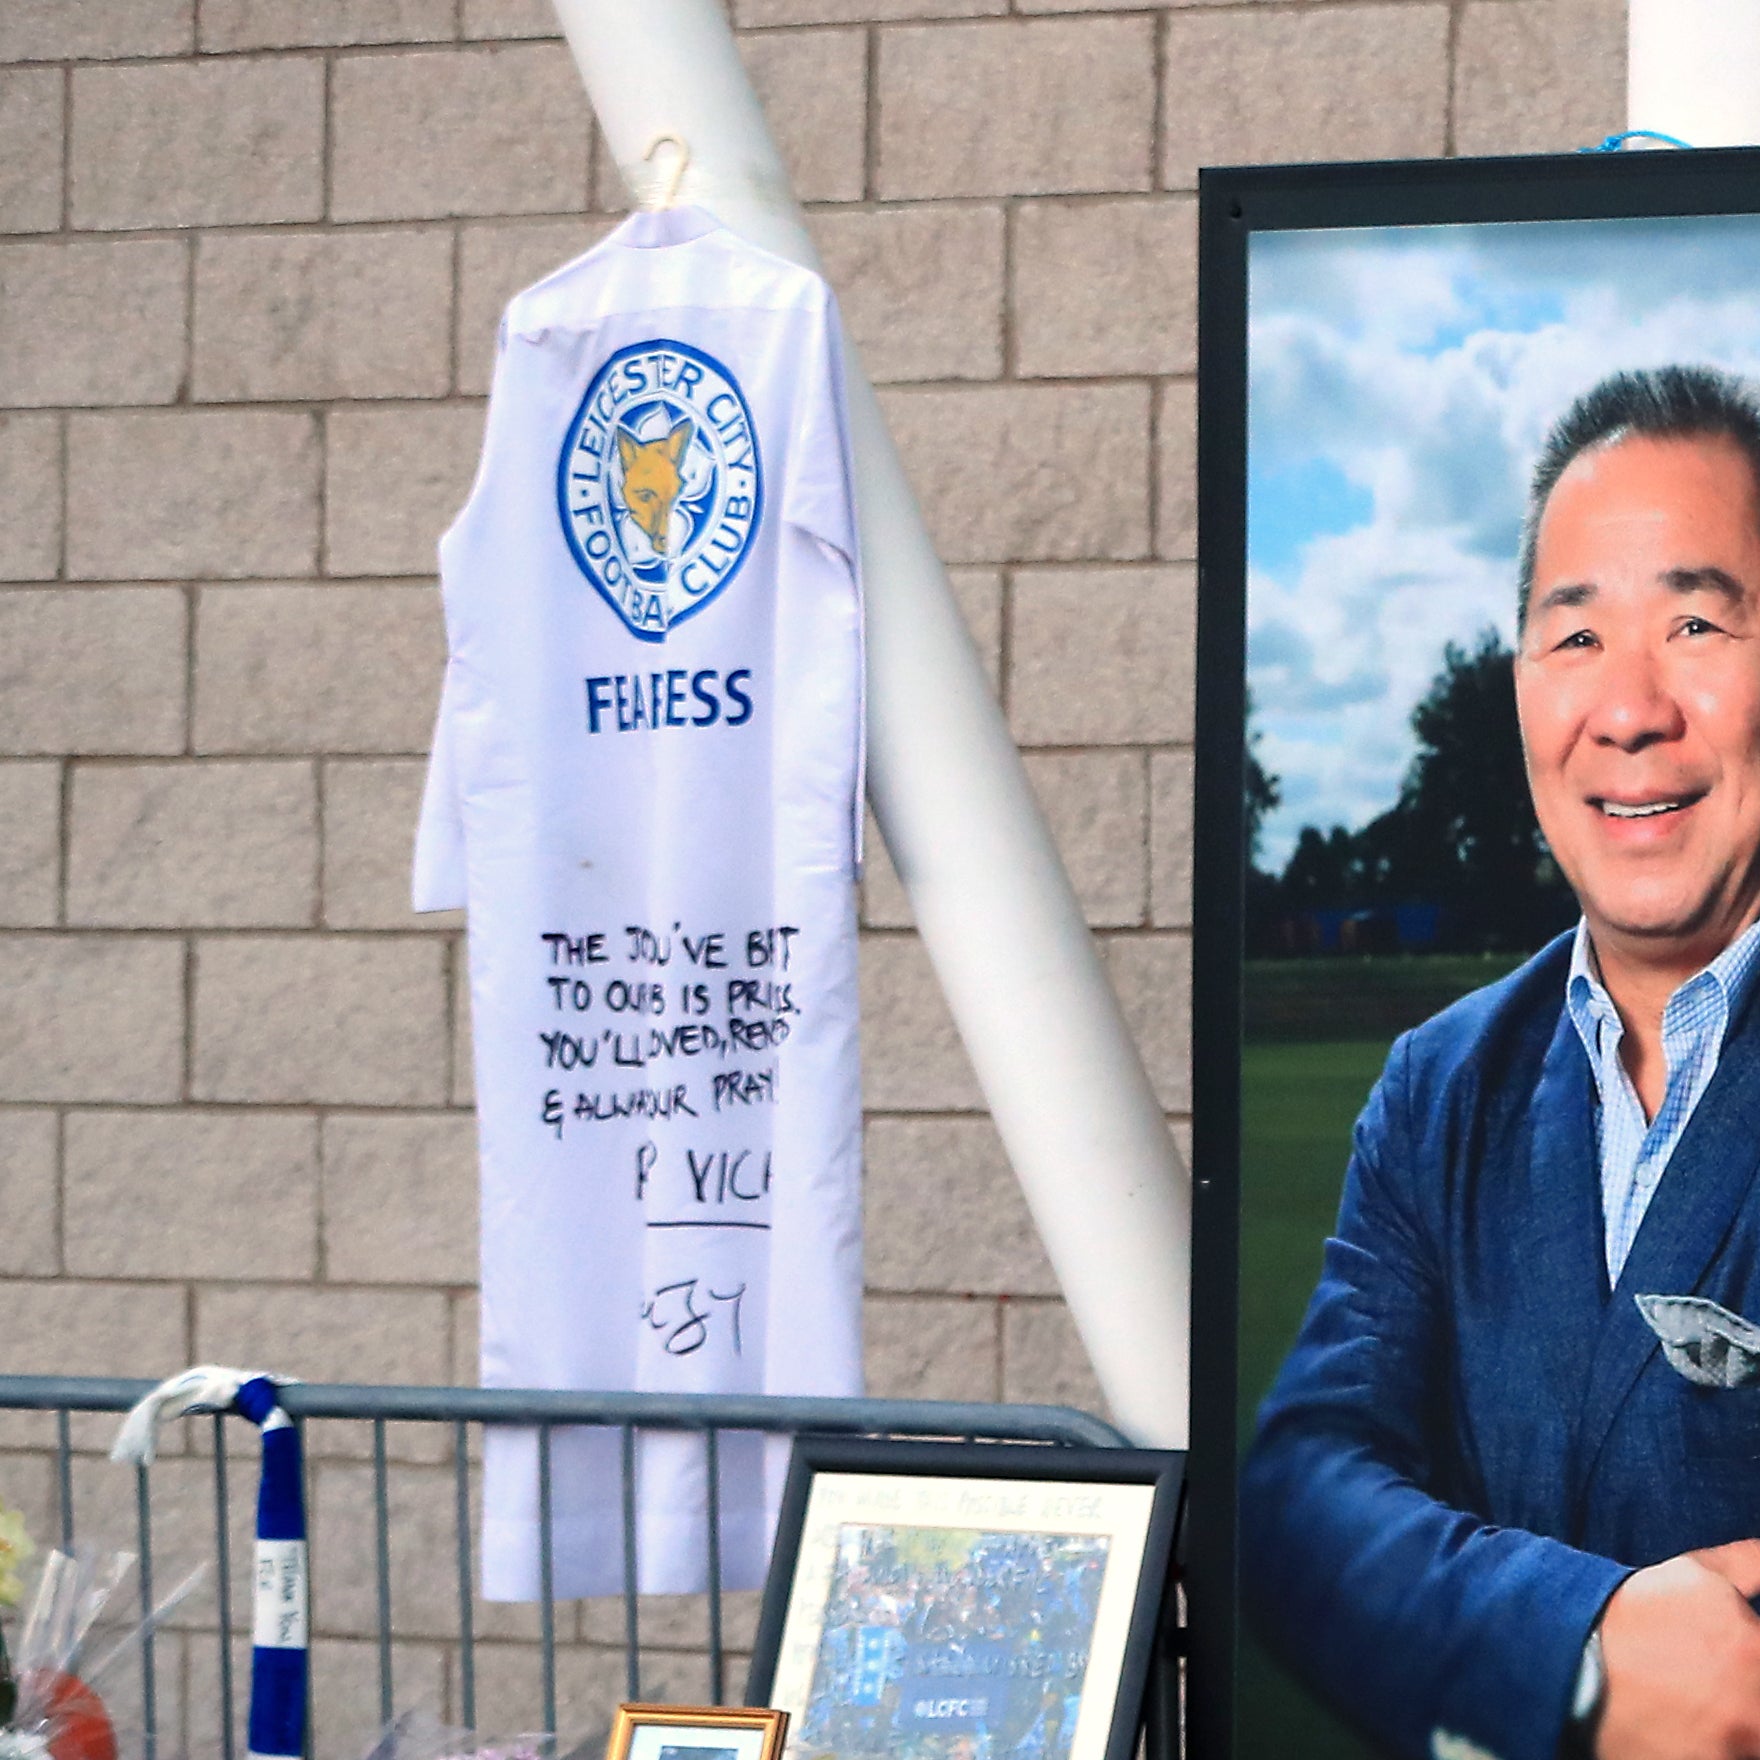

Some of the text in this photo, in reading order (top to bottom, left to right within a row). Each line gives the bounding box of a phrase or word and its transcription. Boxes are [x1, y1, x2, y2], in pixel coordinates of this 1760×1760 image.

[705, 393, 753, 472] CITY
[682, 496, 752, 597] CLUB
[541, 932, 609, 966] THE
[548, 976, 592, 1012] TO
[682, 984, 710, 1015] IS
